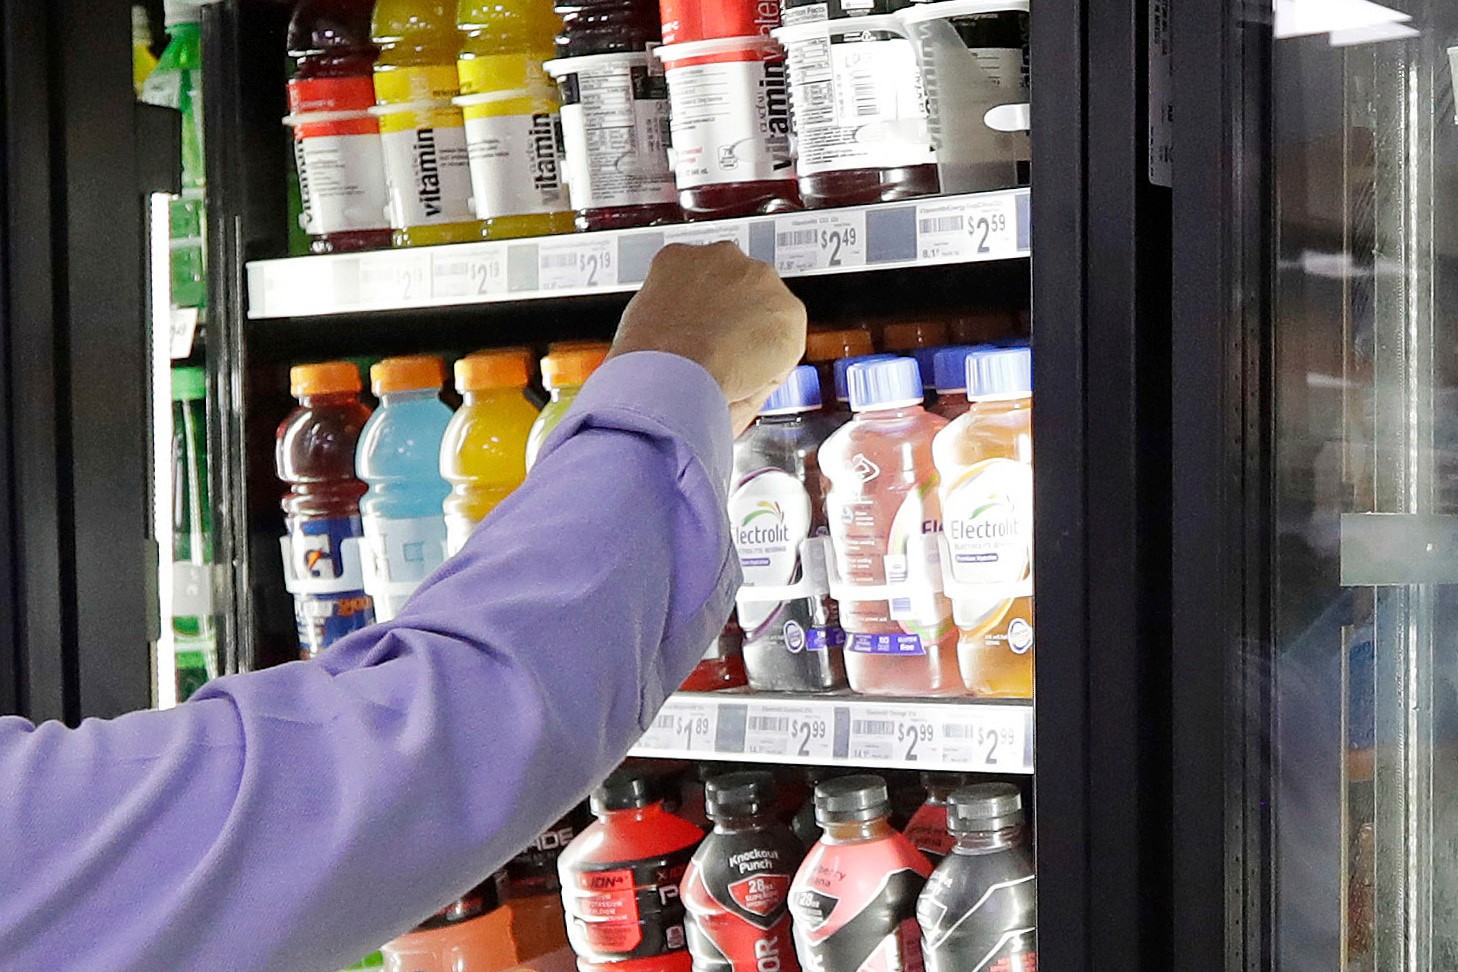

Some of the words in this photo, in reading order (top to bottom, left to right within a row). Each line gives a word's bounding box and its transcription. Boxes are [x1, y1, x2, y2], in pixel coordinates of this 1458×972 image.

[414, 128, 441, 217] vitamin
[821, 227, 857, 266] $249
[968, 214, 1006, 253] $259
[951, 518, 1018, 540] Electrolit
[676, 717, 709, 751] $189
[790, 719, 826, 756] $299
[897, 723, 934, 761] $299
[729, 848, 779, 868] Knockout
[739, 858, 773, 874] Punch
